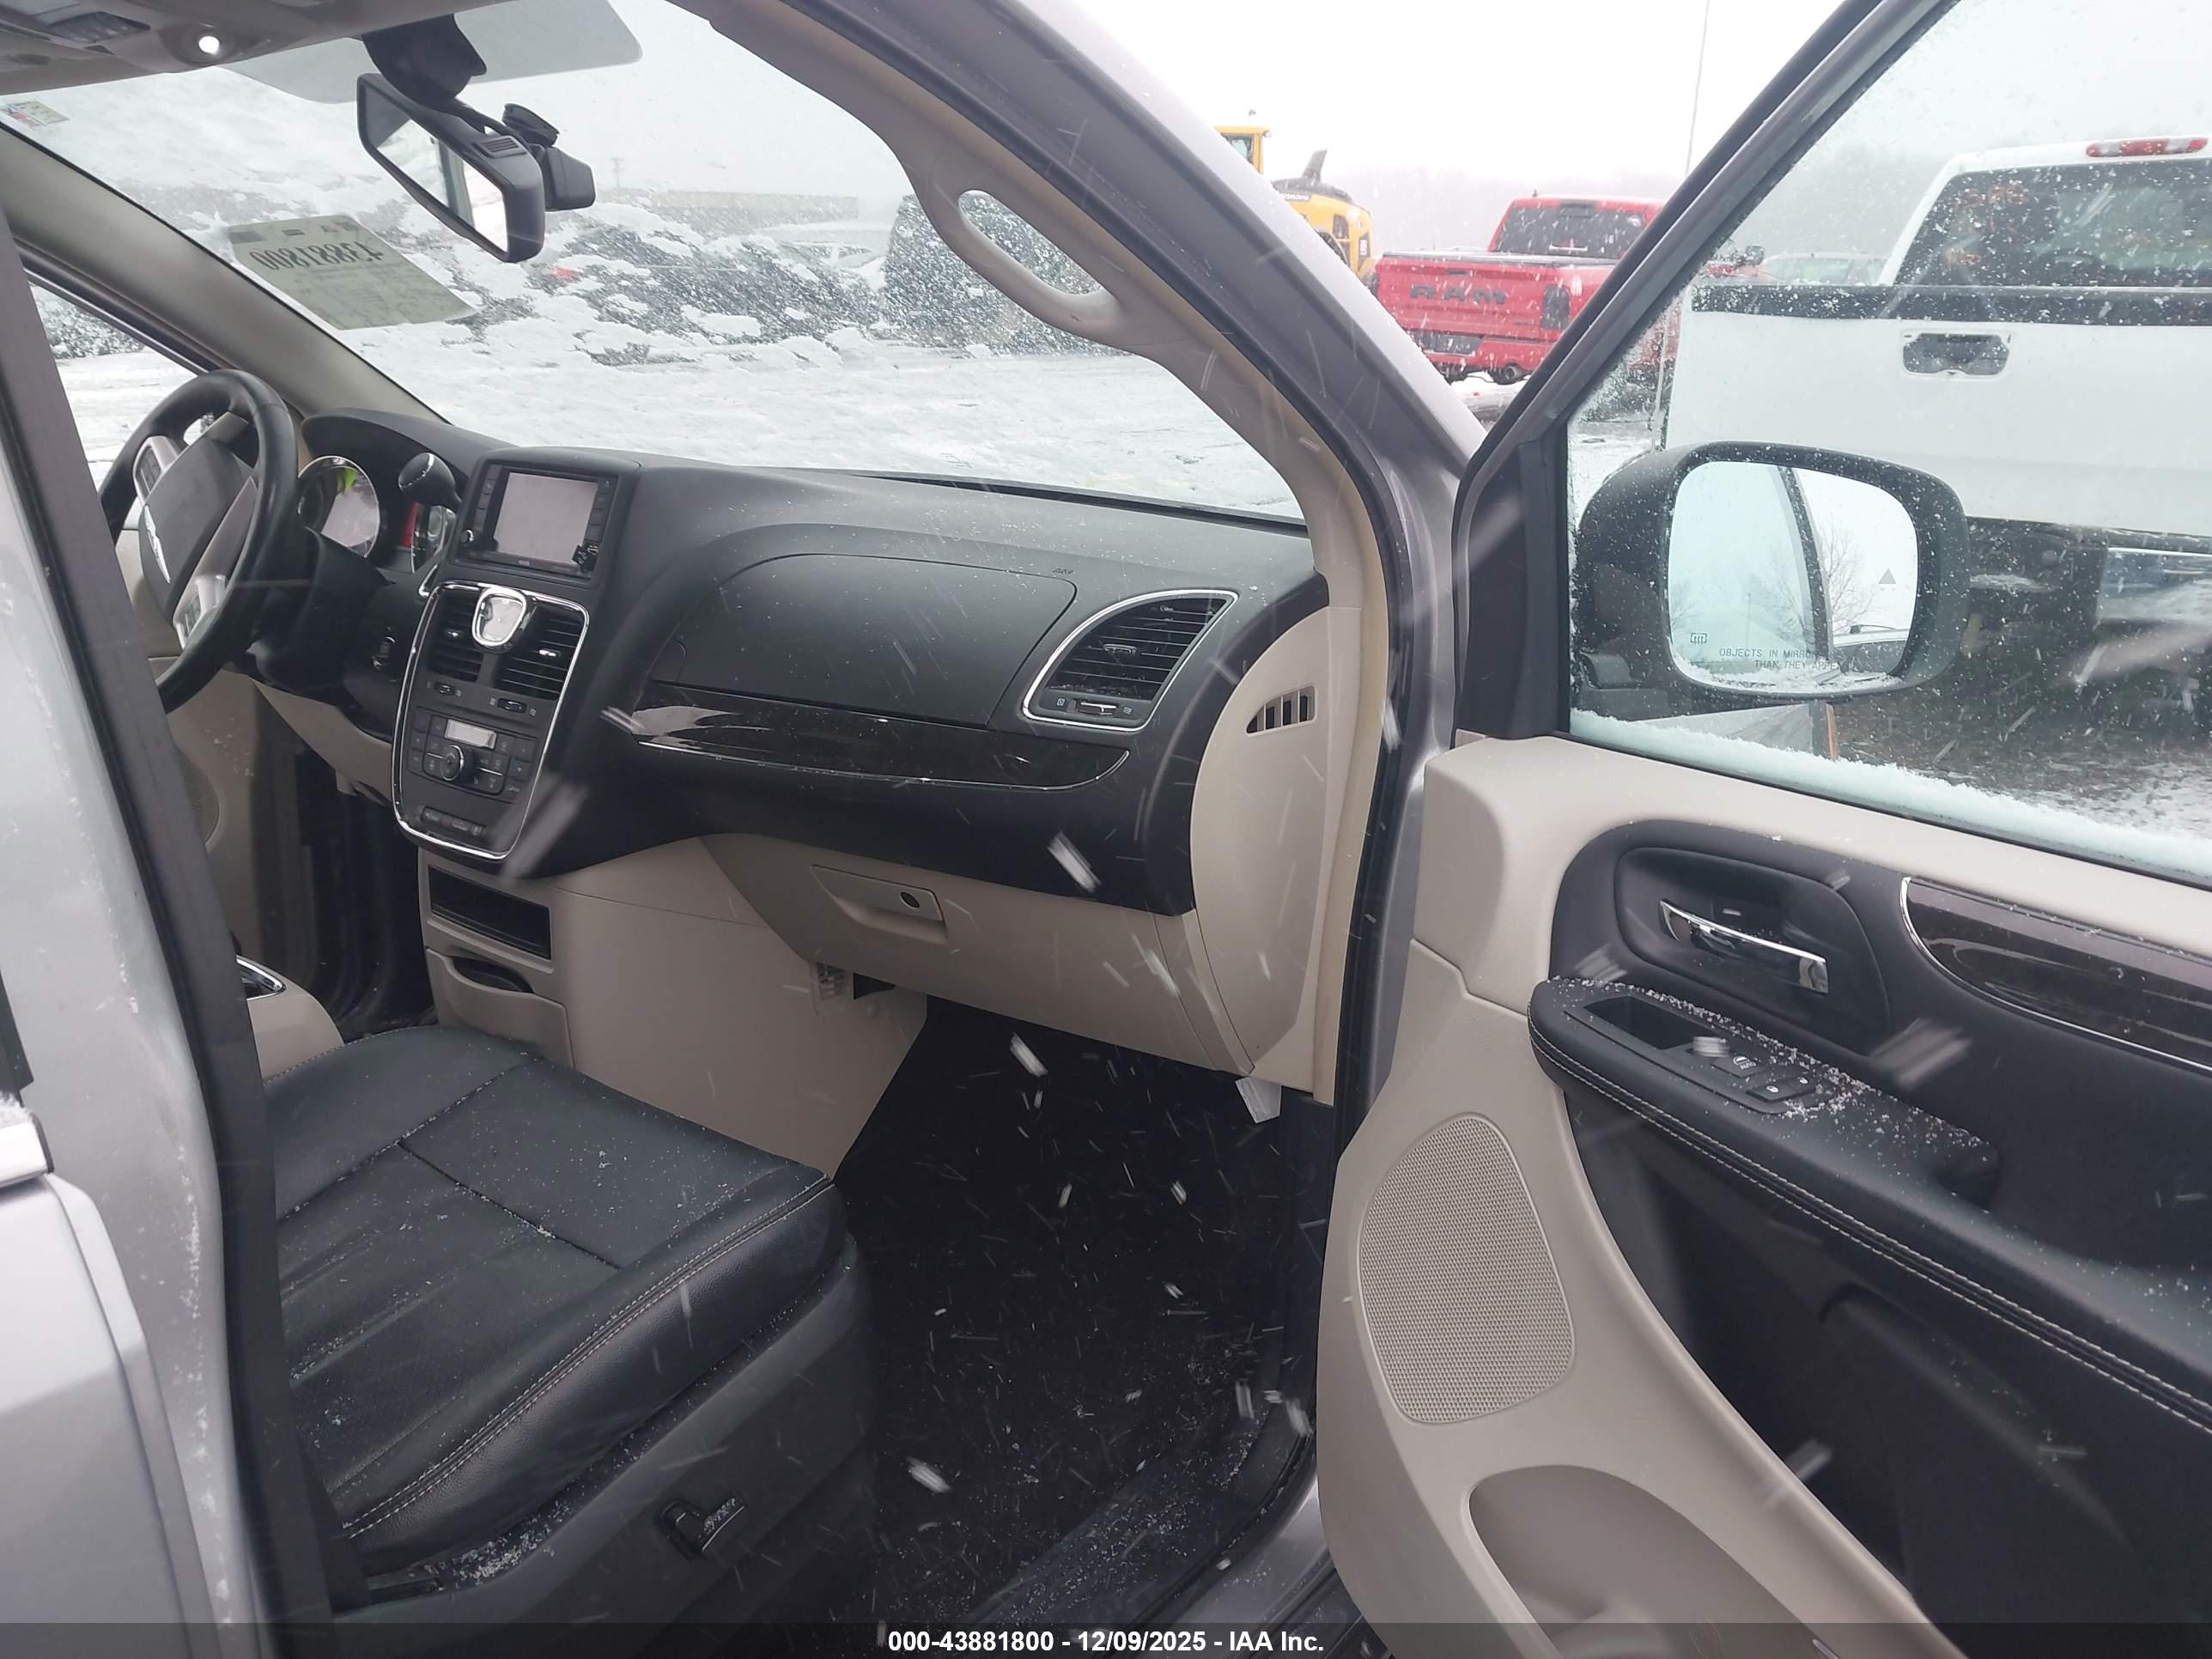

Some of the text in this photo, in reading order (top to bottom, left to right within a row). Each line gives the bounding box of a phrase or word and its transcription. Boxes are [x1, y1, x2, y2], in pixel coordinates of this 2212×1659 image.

[1409, 285, 1506, 305] RAM
[1719, 647, 1814, 659] OBJECTS IN MIRRO
[1754, 659, 1779, 669] THAN
[1784, 660, 1806, 670] THEY
